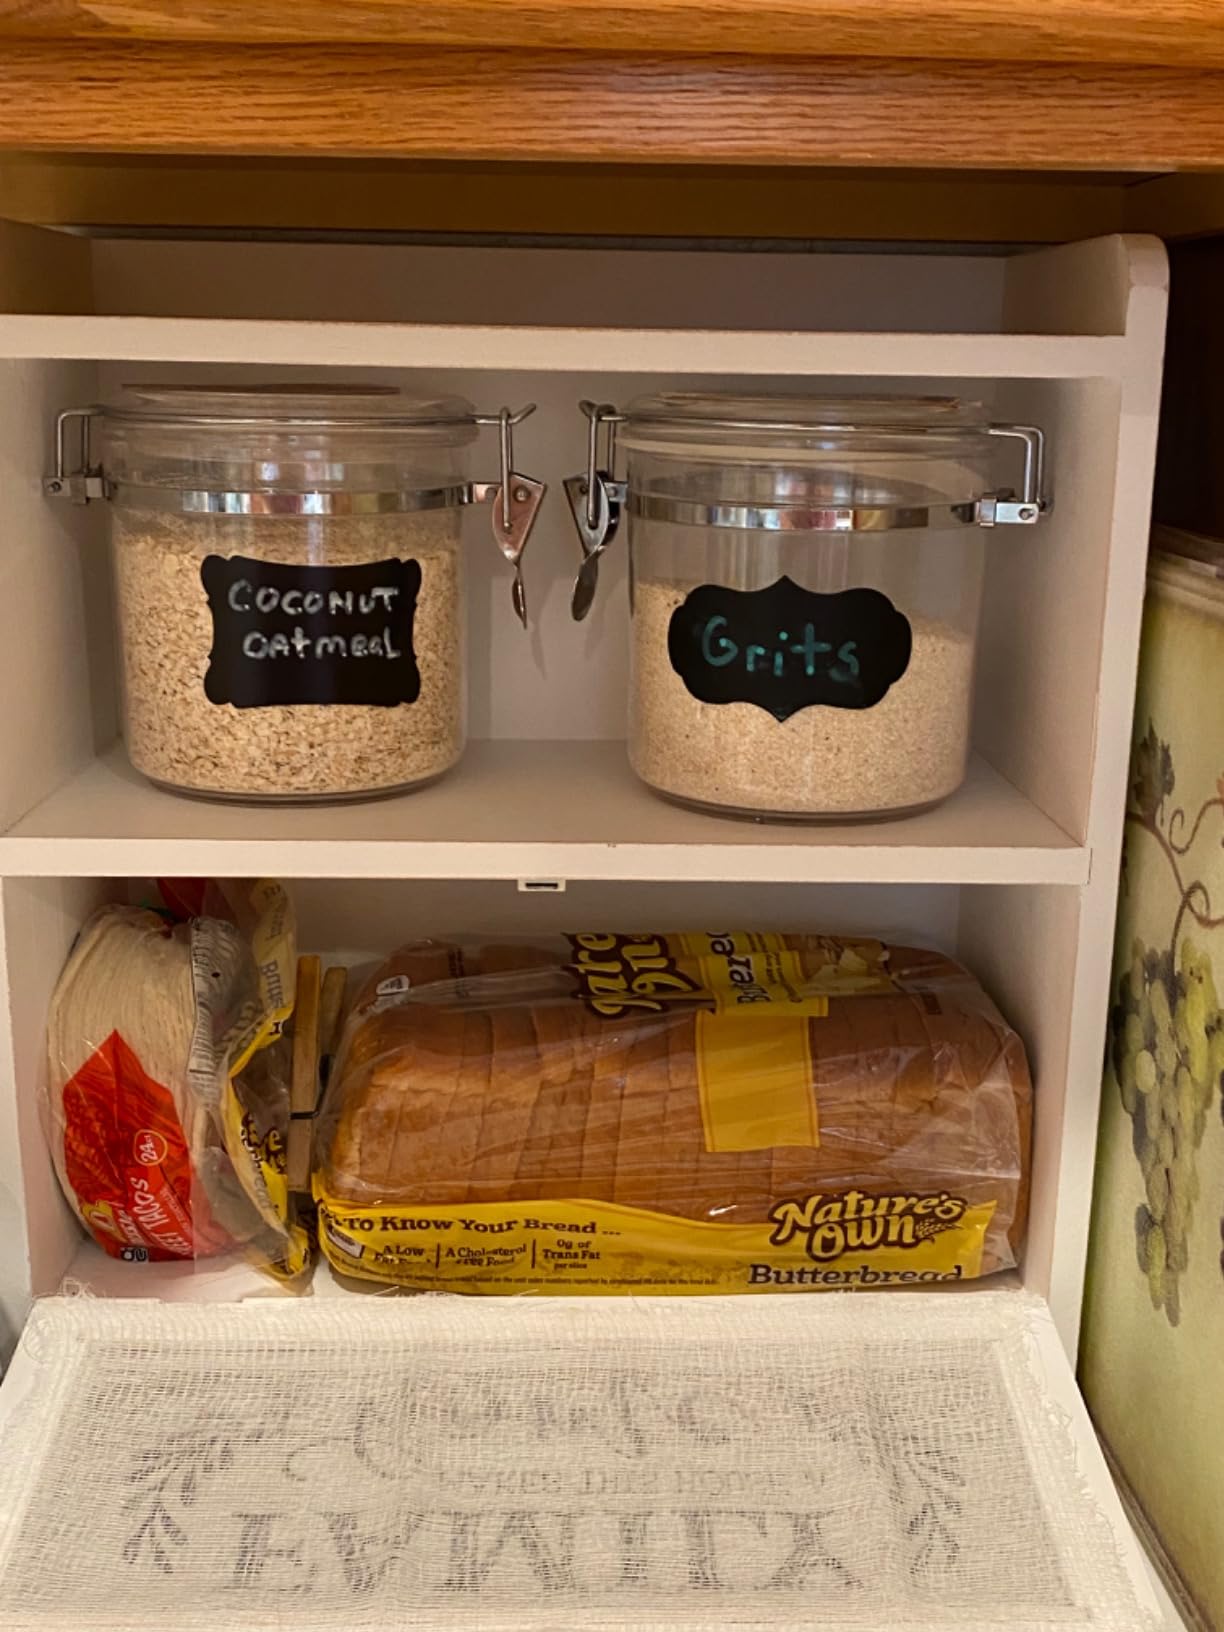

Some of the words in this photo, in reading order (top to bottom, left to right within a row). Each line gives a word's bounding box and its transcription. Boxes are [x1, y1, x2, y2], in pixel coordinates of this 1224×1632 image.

[702, 615, 861, 683] Grits
[129, 1176, 170, 1232] TACOS
[380, 1215, 453, 1232] Know
[458, 1218, 518, 1235] Your
[523, 1218, 597, 1235] Bread
[769, 1190, 967, 1246] Nature's
[543, 1249, 579, 1261] Trans
[805, 1213, 919, 1262] Own
[747, 1263, 963, 1286] Butterbread
